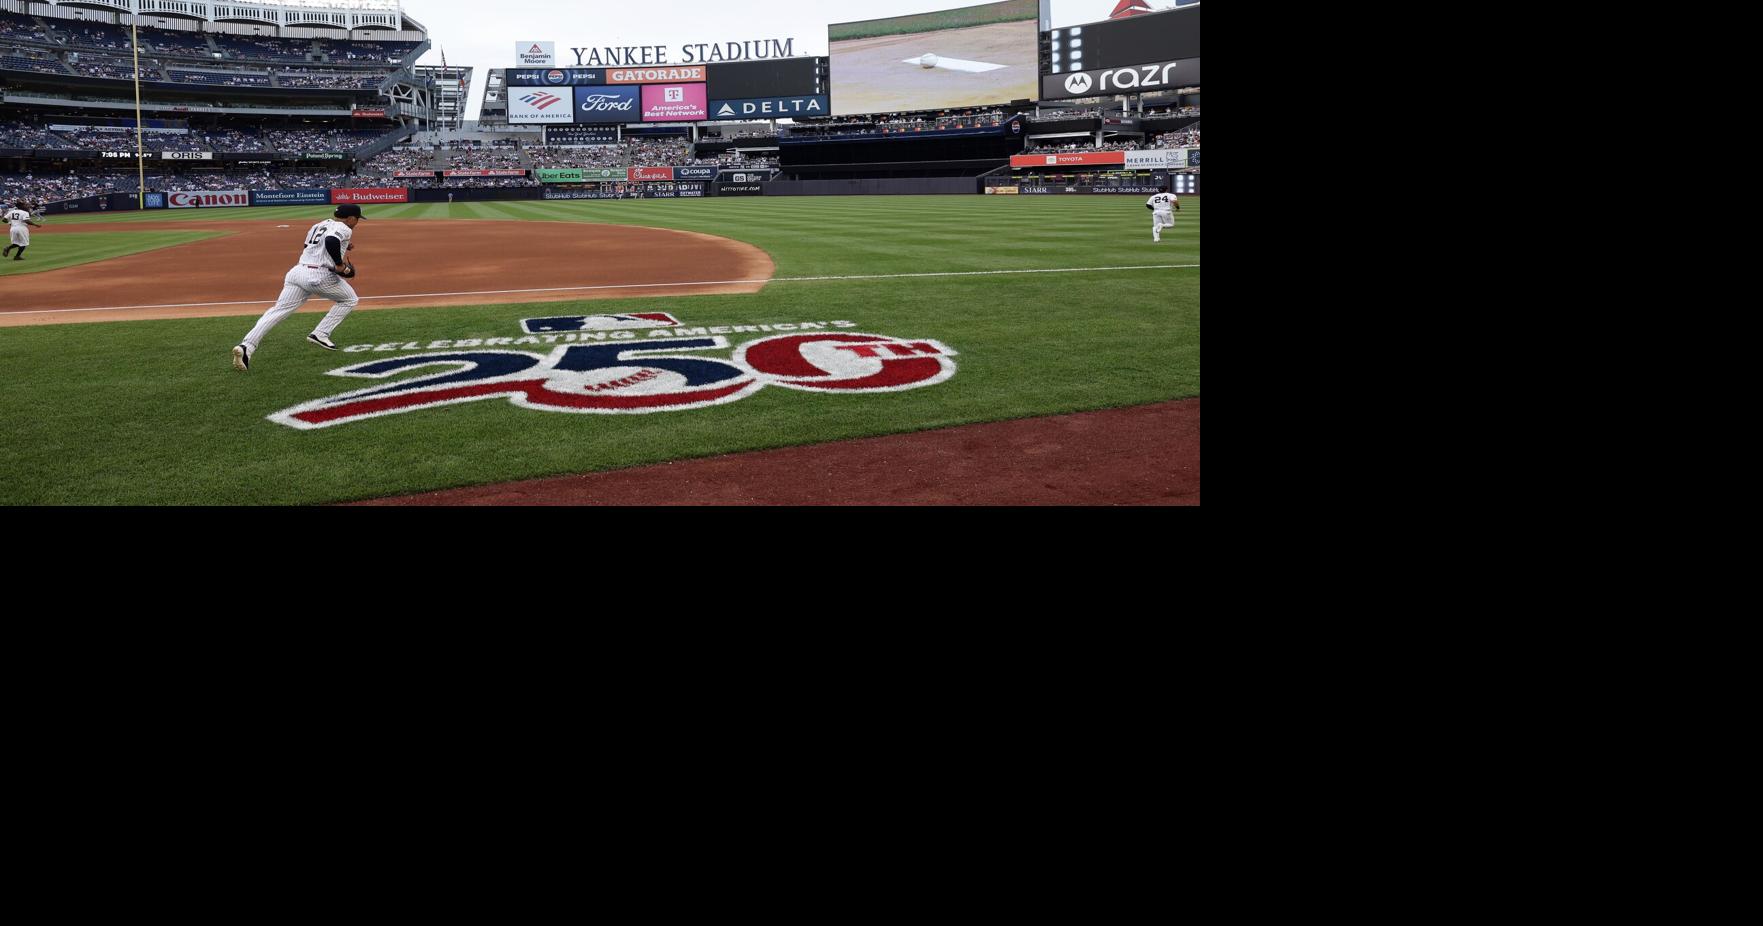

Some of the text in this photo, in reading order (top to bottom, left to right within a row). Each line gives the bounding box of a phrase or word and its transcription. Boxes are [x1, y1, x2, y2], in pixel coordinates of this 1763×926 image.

[571, 38, 795, 66] YANKEE STADIUM
[520, 54, 552, 63] Benjamin
[612, 70, 702, 82] GATORADE
[1100, 63, 1177, 91] razr
[581, 94, 634, 112] Ford
[651, 104, 697, 112] America's
[743, 99, 821, 114] DELTA
[645, 110, 706, 119] Best Network
[169, 193, 247, 206] Canon
[352, 192, 404, 201] Budweiser
[1154, 195, 1169, 204] 24
[11, 213, 20, 221] 13
[308, 226, 328, 245] 12
[343, 319, 858, 352] CELEBRATING AMERICA'S
